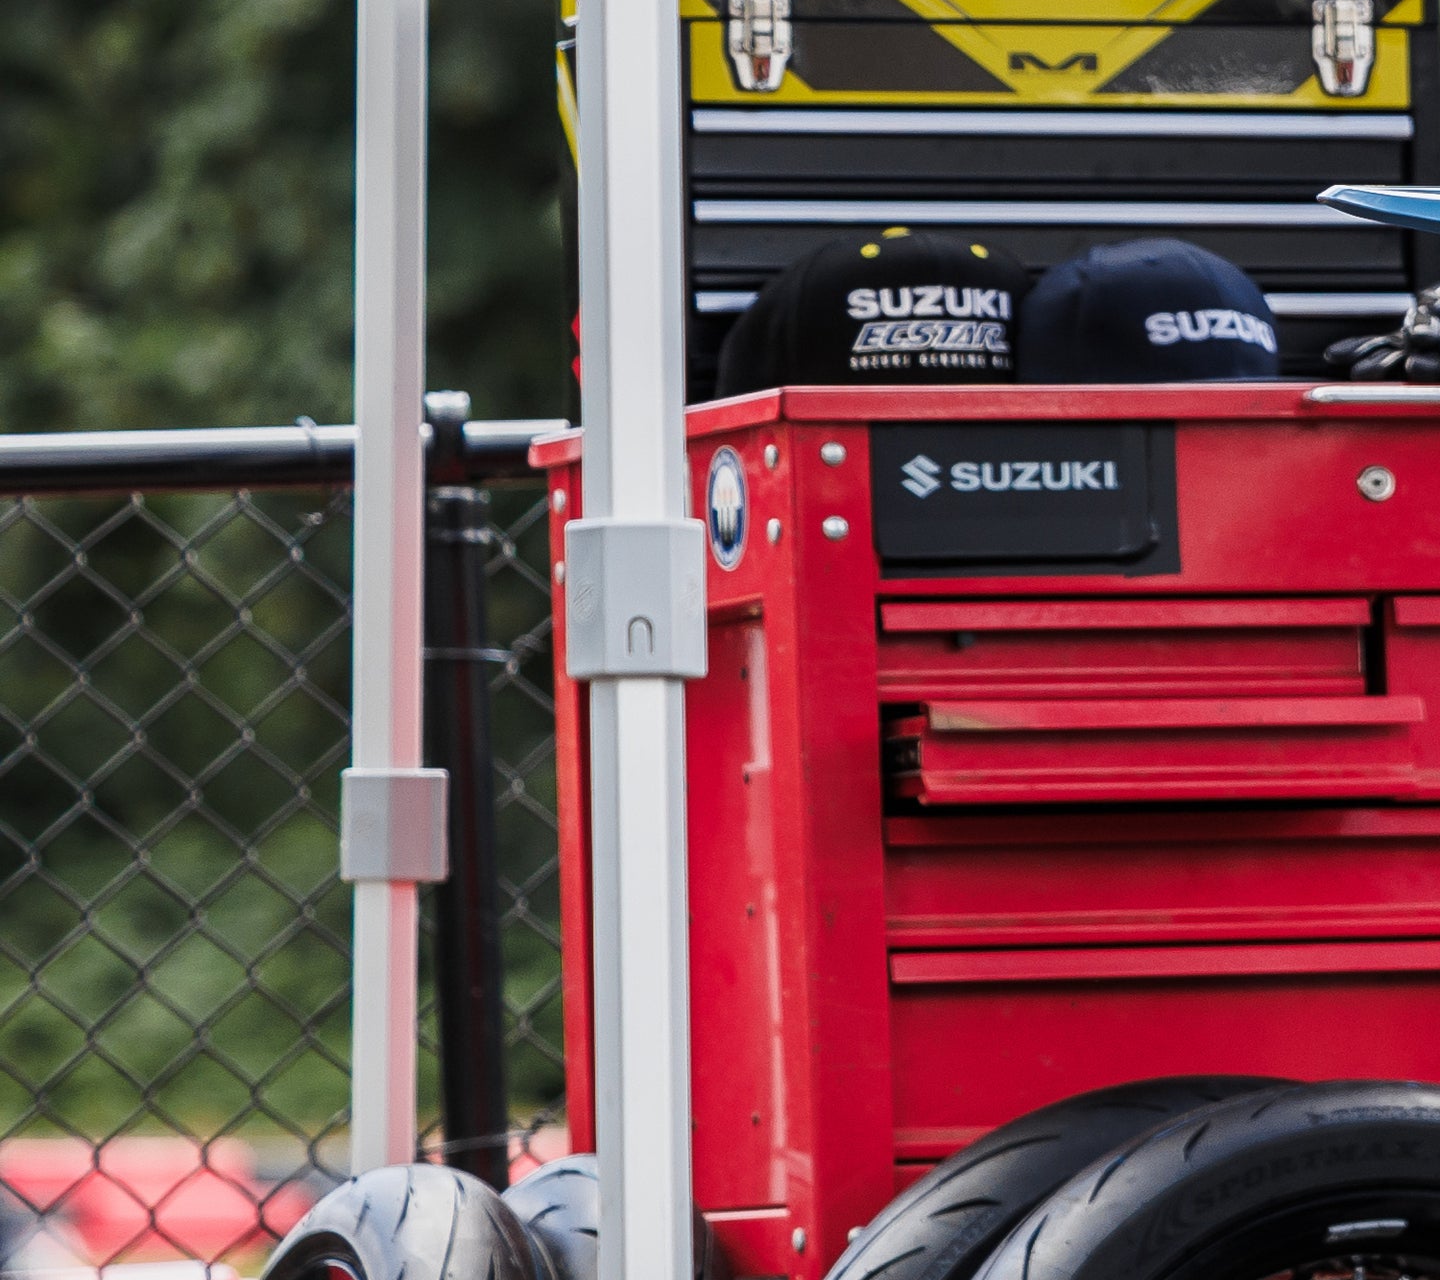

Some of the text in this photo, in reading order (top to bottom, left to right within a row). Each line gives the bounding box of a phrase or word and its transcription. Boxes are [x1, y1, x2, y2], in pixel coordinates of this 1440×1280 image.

[847, 285, 1011, 320] SUZUKI
[852, 321, 1010, 352] ECSTAR
[950, 461, 1118, 491] SUZUKI
